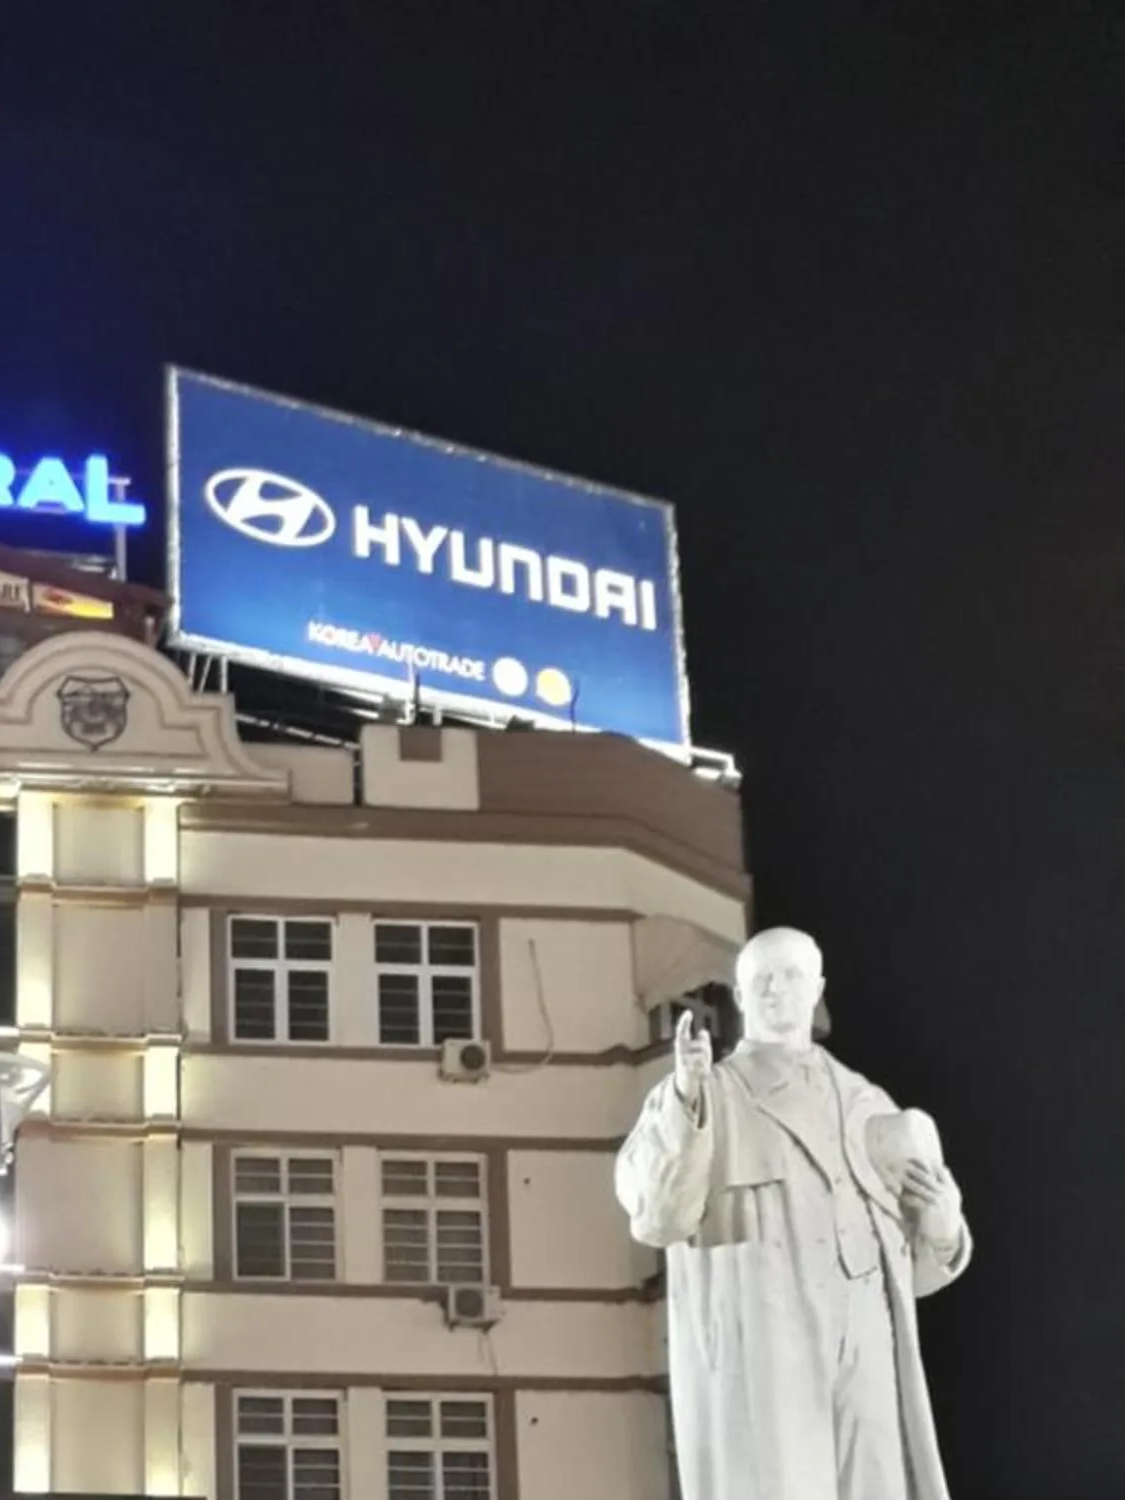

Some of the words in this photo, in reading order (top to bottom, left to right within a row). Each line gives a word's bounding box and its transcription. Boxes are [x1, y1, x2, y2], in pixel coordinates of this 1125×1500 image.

[352, 505, 658, 631] HYUNDAI
[307, 619, 373, 654] KOREA
[376, 637, 486, 681] AUTOTRADE
